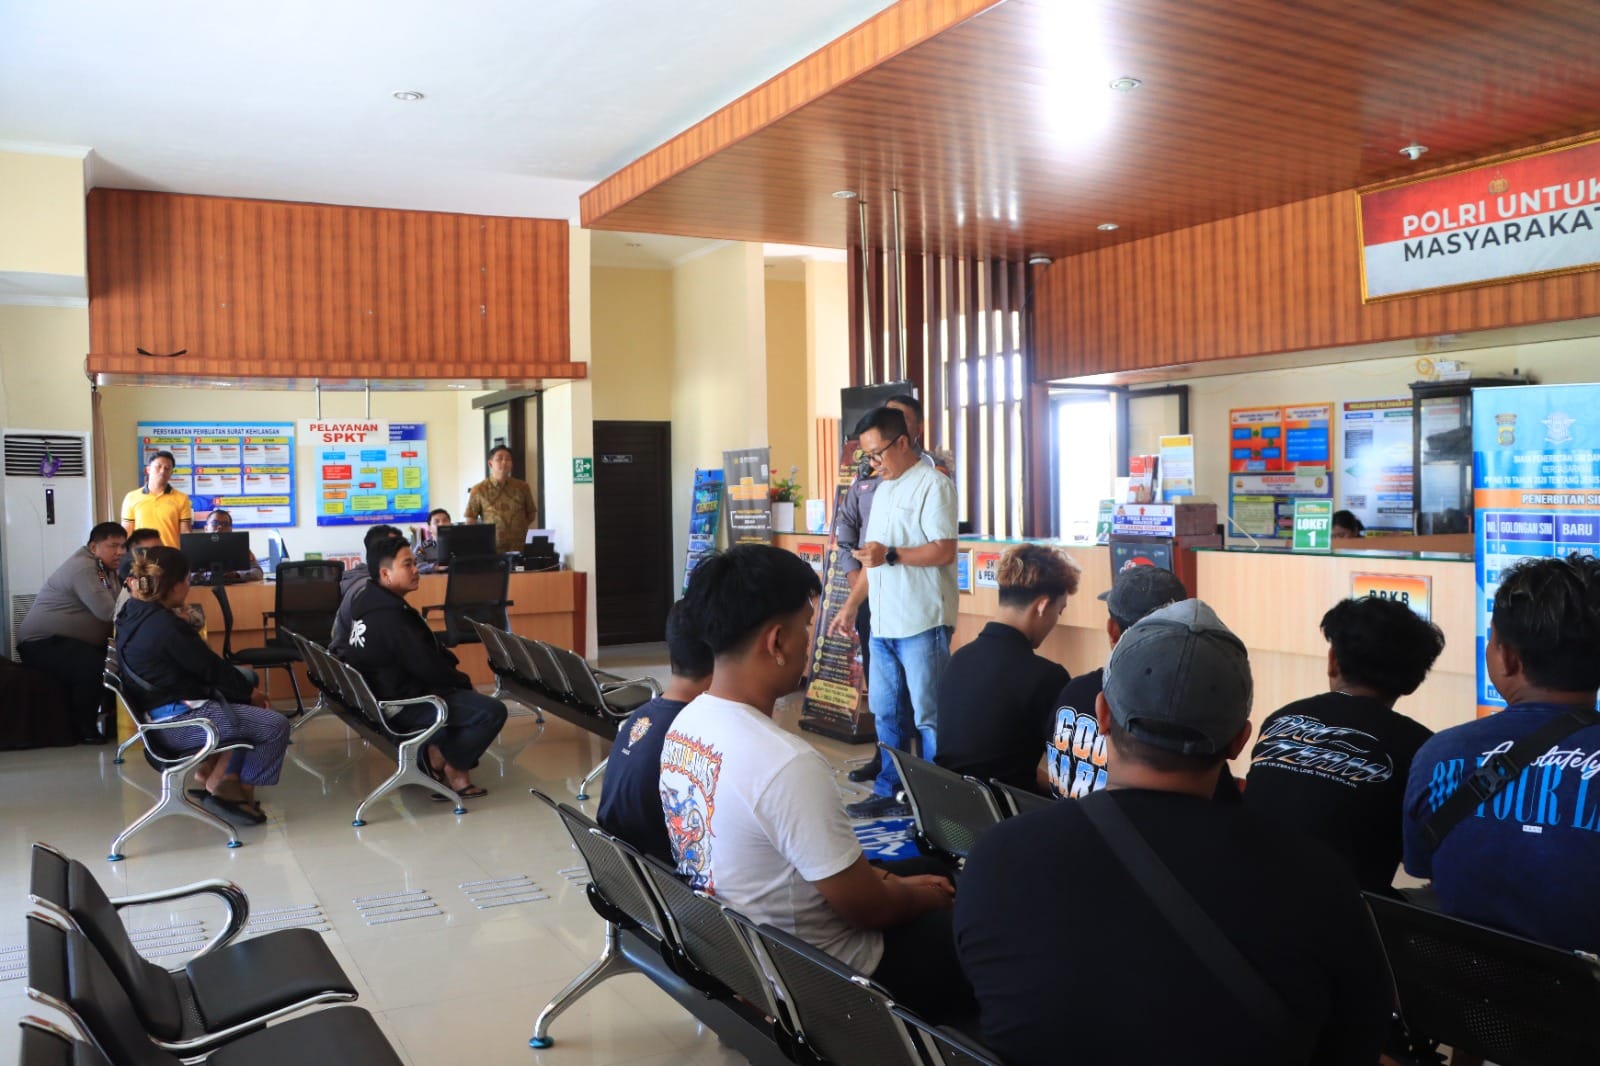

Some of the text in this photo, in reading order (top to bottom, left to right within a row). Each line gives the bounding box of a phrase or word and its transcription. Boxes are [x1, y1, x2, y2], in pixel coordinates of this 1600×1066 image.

[1402, 201, 1486, 236] POLRI
[309, 423, 379, 432] PELAYANAN
[323, 432, 367, 443] SPKT
[1521, 494, 1585, 505] PENERBITAN
[1297, 518, 1329, 530] LOKET
[1501, 521, 1538, 534] GOLONGAN
[1539, 522, 1553, 535] SIM
[1562, 523, 1593, 536] BARU
[1307, 530, 1317, 547] 1
[984, 571, 997, 581] PER
